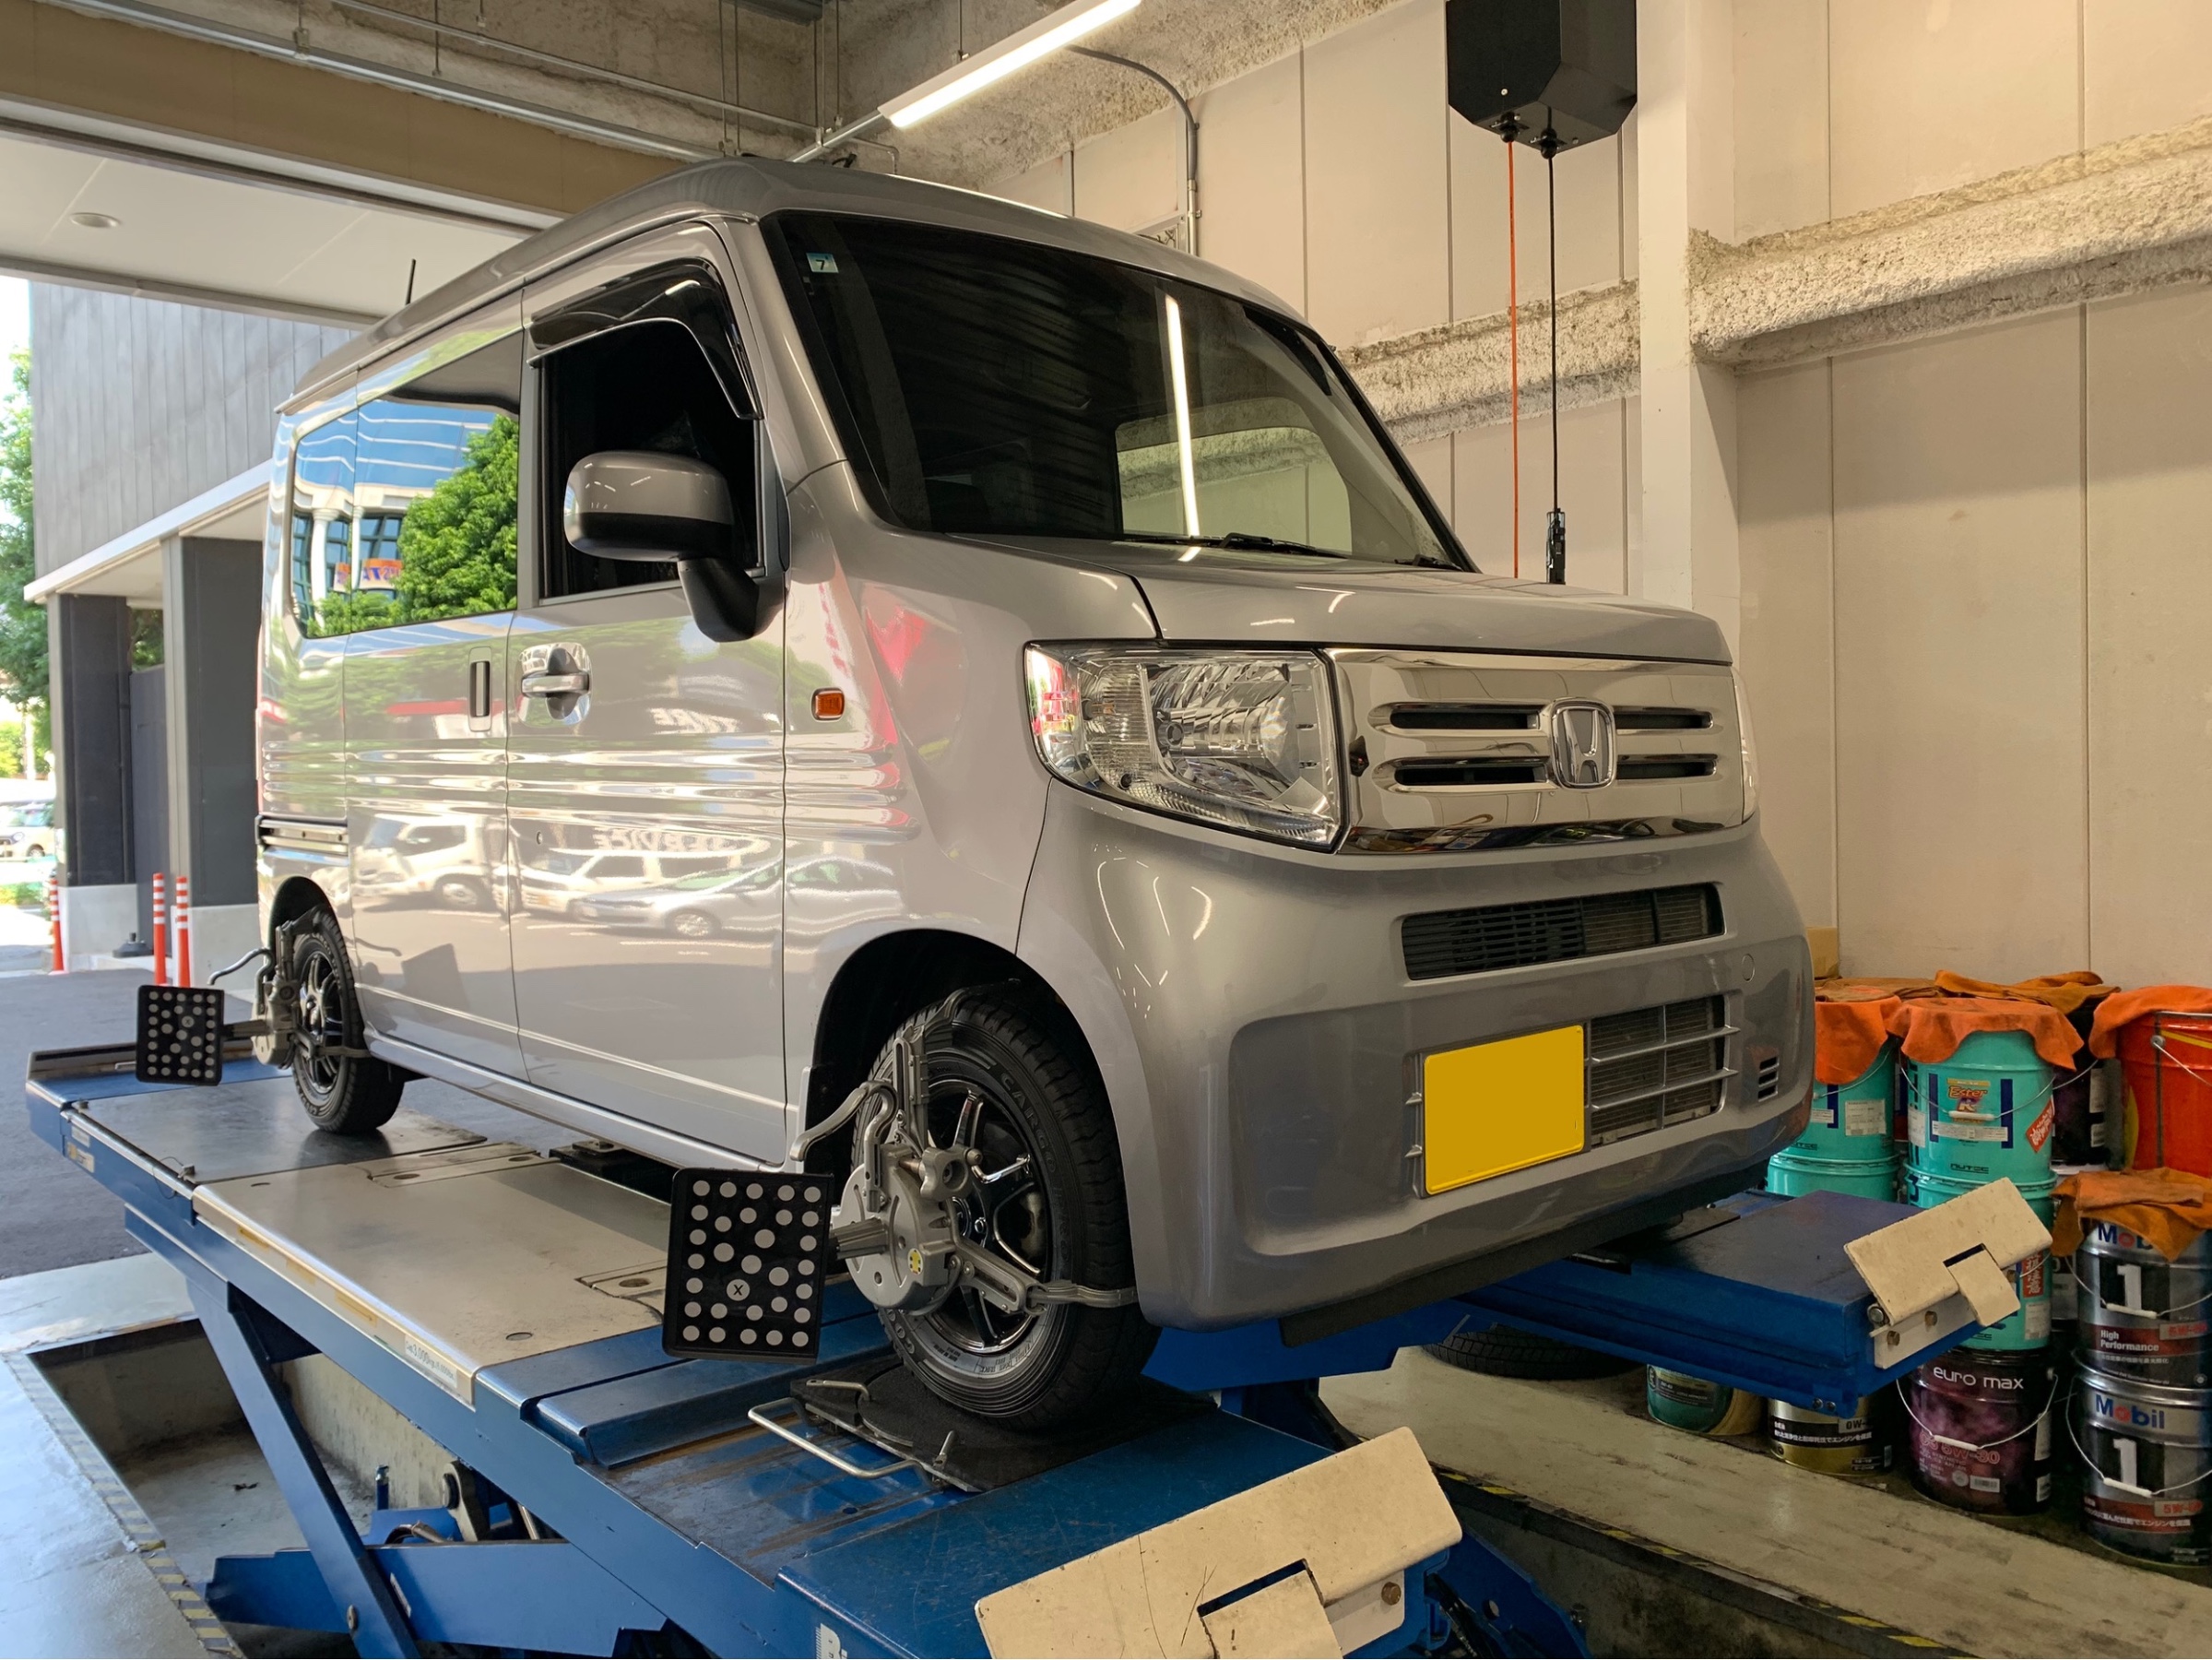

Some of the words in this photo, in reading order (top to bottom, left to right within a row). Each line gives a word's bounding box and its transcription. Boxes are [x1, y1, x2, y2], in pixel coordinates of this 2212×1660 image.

[815, 259, 825, 270] 7
[1948, 1085, 1988, 1099] Ester
[2116, 1263, 2142, 1310] 1
[2100, 1330, 2120, 1340] High
[2100, 1339, 2159, 1352] Performance
[1933, 1366, 1977, 1386] euro
[1983, 1376, 2024, 1390] max
[2095, 1393, 2165, 1429] Mobil
[2112, 1438, 2137, 1487] 1
